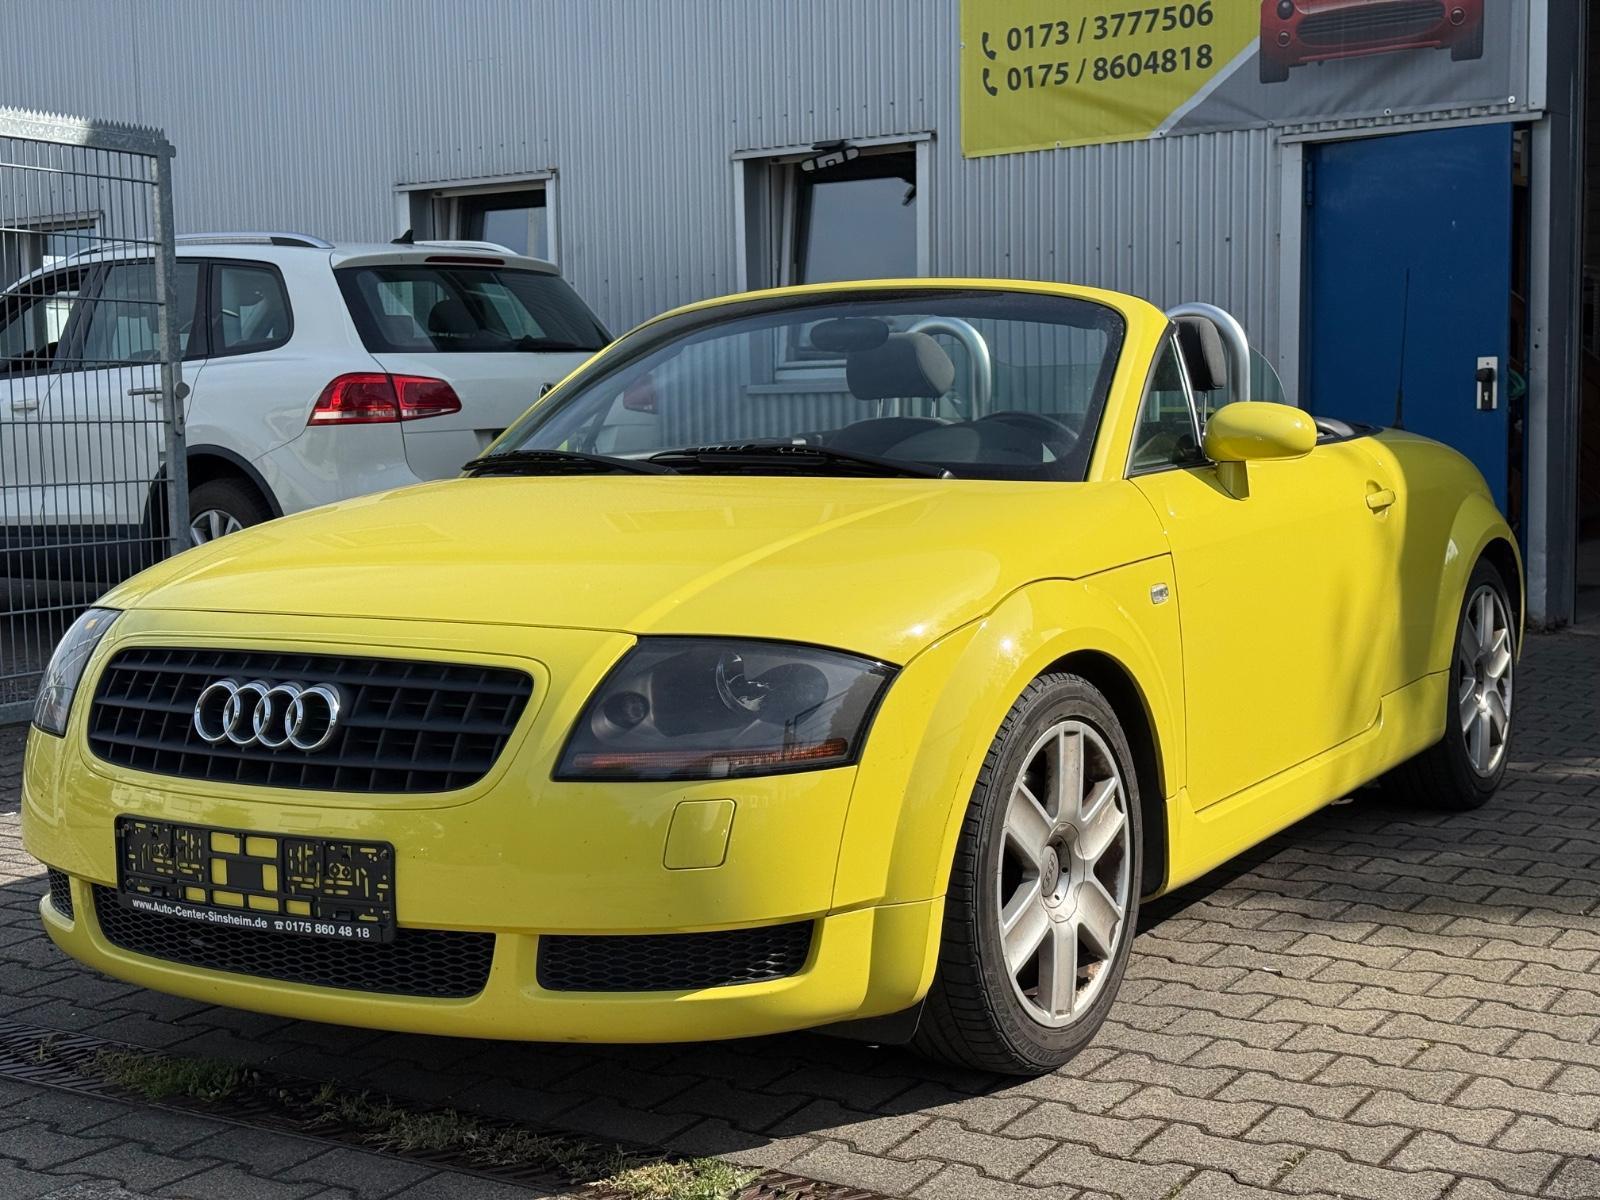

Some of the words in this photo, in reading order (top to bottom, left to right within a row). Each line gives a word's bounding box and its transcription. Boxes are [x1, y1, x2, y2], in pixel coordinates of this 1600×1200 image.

[1006, 20, 1070, 51] 0173
[1076, 16, 1087, 44] /
[1093, 0, 1214, 40] 3777506
[1006, 61, 1069, 91] 0175
[1075, 58, 1087, 84] /
[1093, 43, 1213, 82] 8604818
[132, 898, 268, 929] www.Auto-Center-Sinsheim.de
[285, 920, 312, 933] 0175
[315, 923, 336, 936] 860
[338, 925, 353, 937] 48
[355, 927, 370, 939] 18
